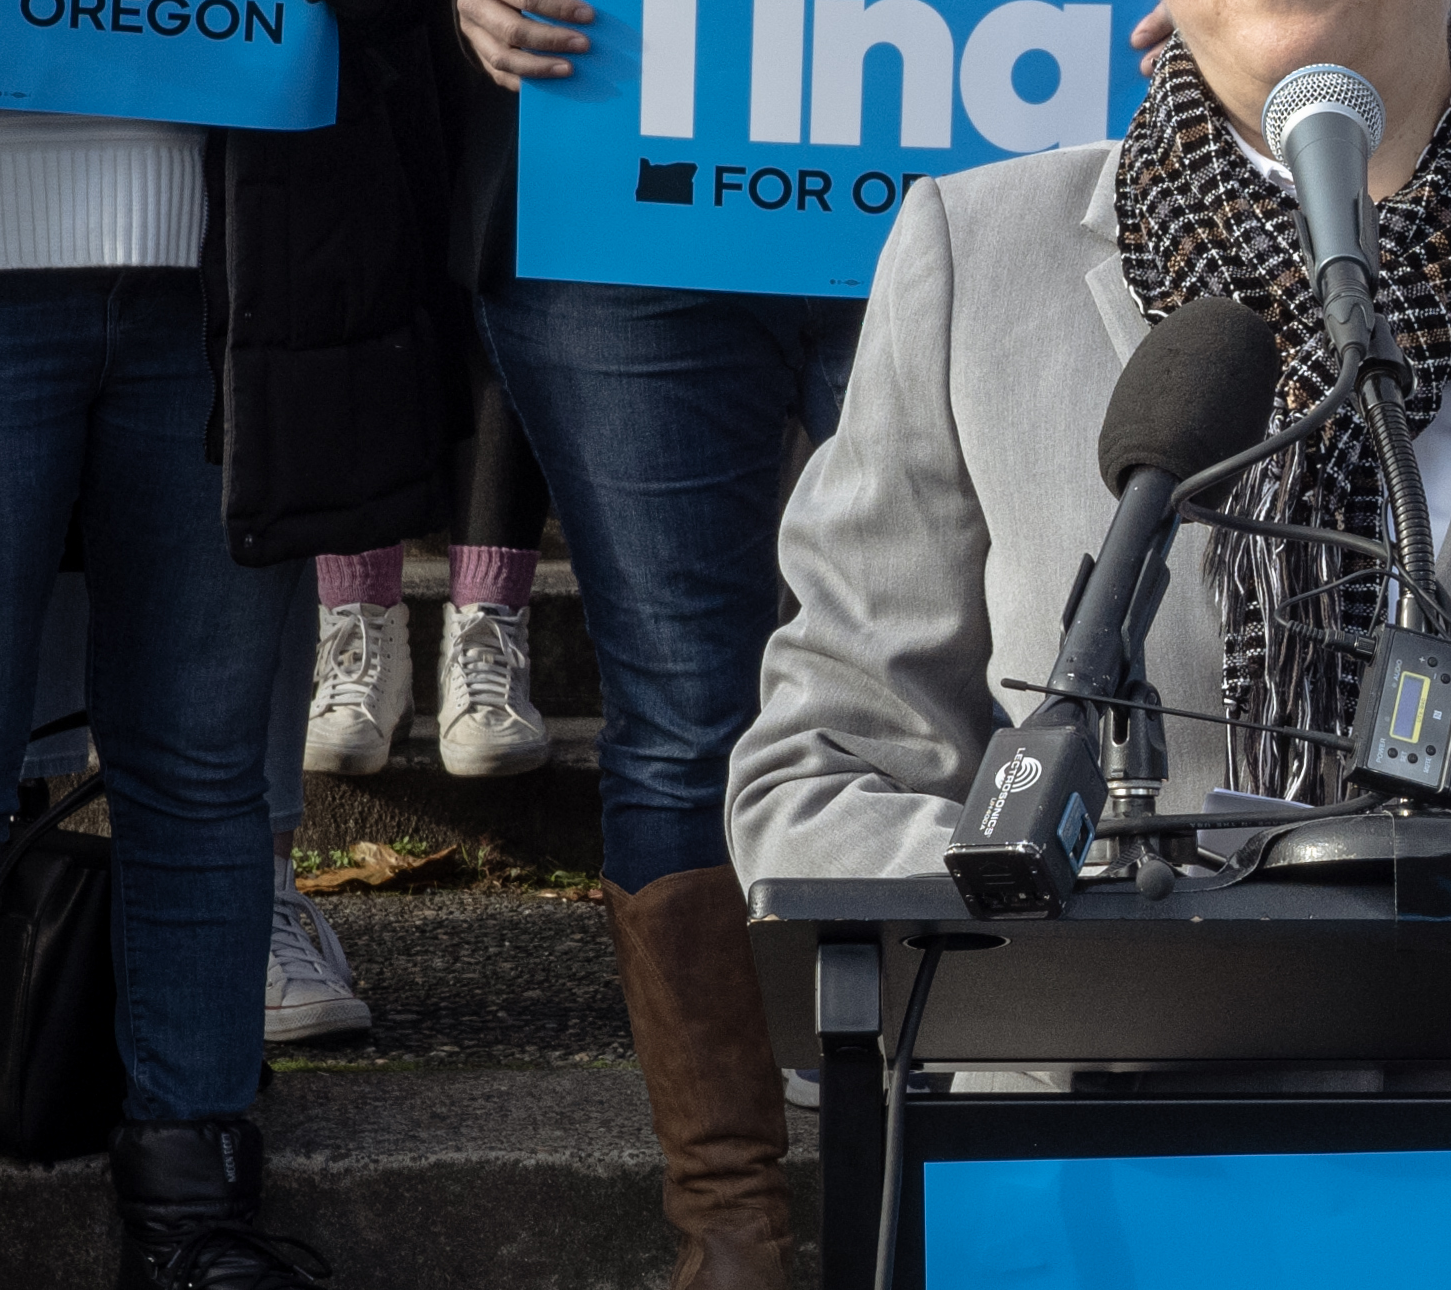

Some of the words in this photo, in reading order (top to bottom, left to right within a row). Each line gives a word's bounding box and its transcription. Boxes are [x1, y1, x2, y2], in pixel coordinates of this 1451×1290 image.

[714, 166, 832, 212] FOR
[1376, 738, 1386, 764] POWER
[984, 747, 1027, 838] LECTROSONICS
